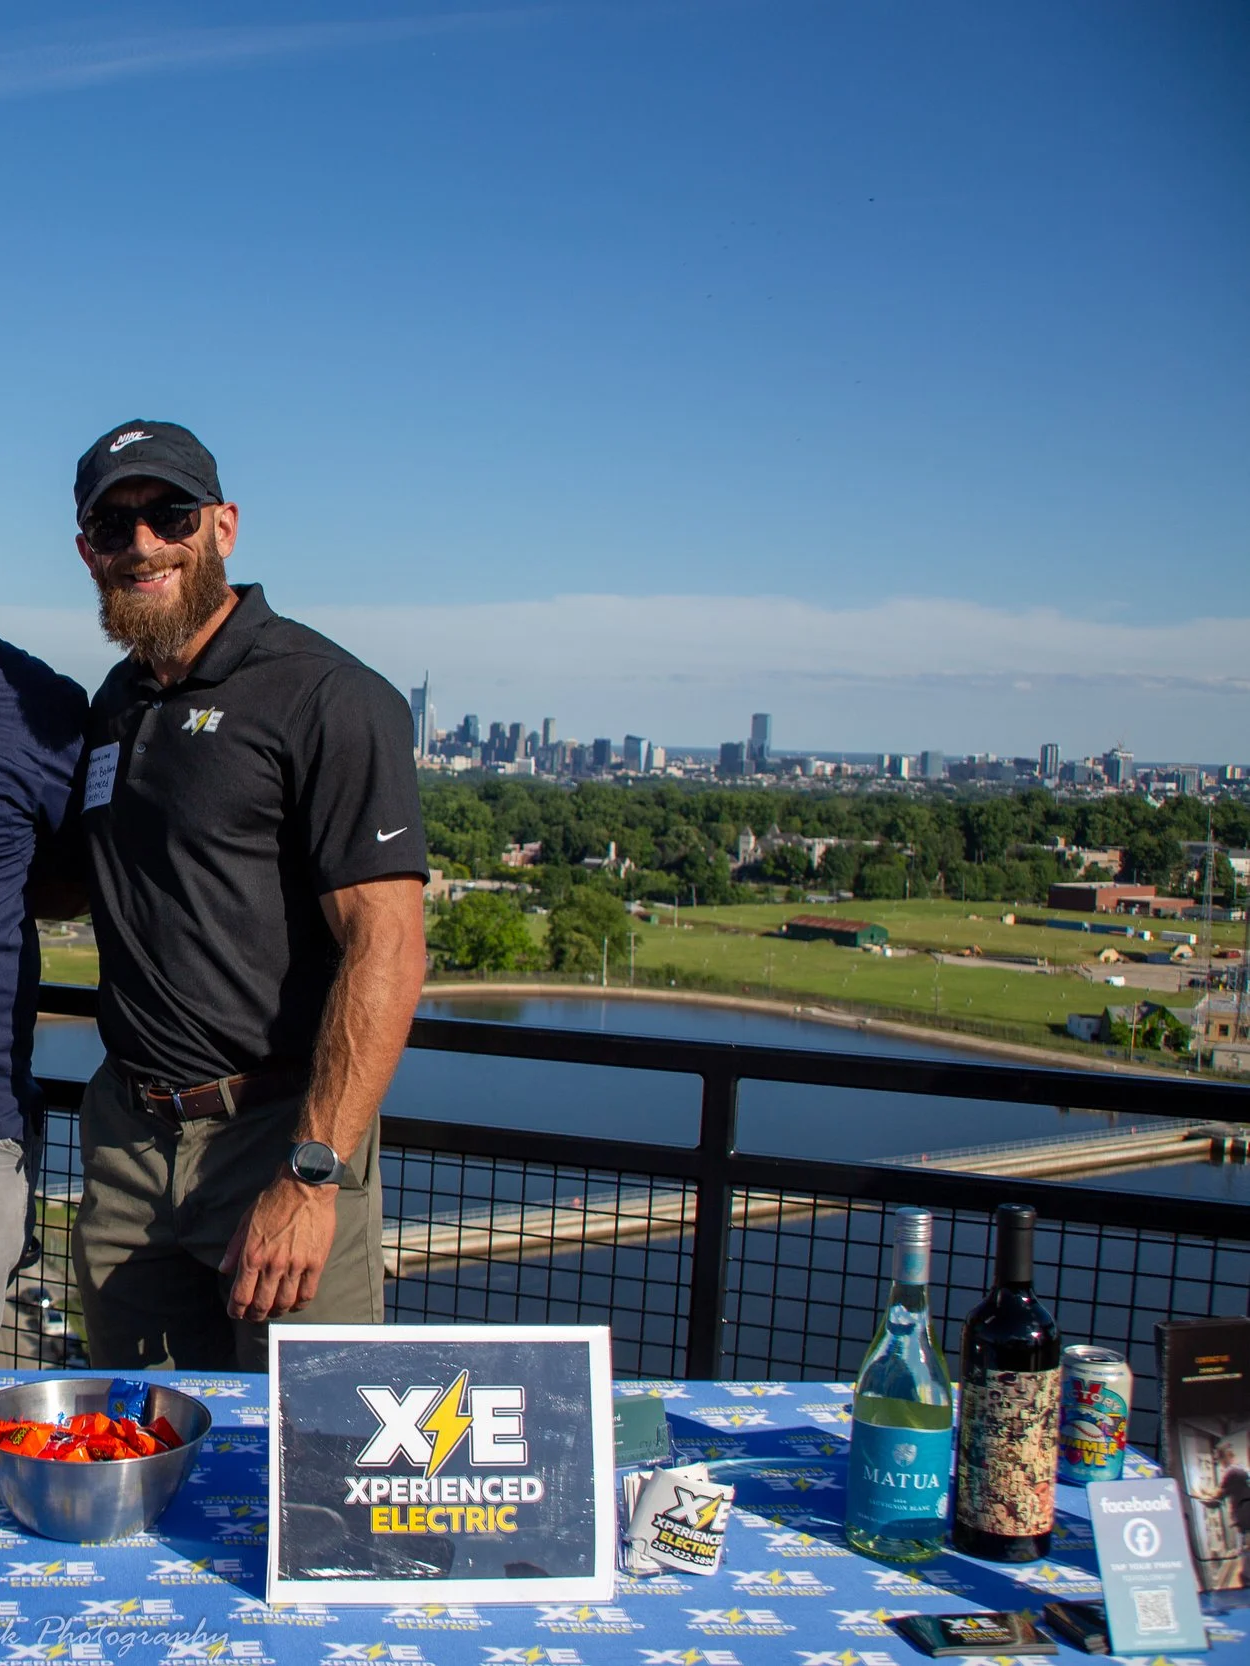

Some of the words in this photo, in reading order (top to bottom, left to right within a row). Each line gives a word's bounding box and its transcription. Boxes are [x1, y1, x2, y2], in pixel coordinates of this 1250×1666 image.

[117, 430, 145, 444] NIKE
[863, 1465, 940, 1490] MATUA
[344, 1475, 546, 1506] XPERIENCED
[909, 1504, 931, 1512] BLANC
[1100, 1495, 1173, 1514] facebook
[370, 1505, 519, 1534] ELECTRIC
[659, 1531, 717, 1556] ELECTRIC
[1129, 1562, 1152, 1570] YOUR
[1154, 1561, 1183, 1569] PHONE
[147, 1574, 254, 1582] XPERIENCED
[732, 1584, 837, 1592] XPERIENCED
[748, 1589, 826, 1597] ELECTRIC
[228, 1613, 338, 1622] XPERIENCED
[241, 1618, 326, 1627] ELECTRIC
[382, 1618, 493, 1627] XPERIENCED
[397, 1623, 481, 1631] ELECTRIC
[534, 1621, 645, 1630] XPERIENCED
[686, 1623, 797, 1631] XPERIENCED
[550, 1626, 633, 1635] ELECTRIC
